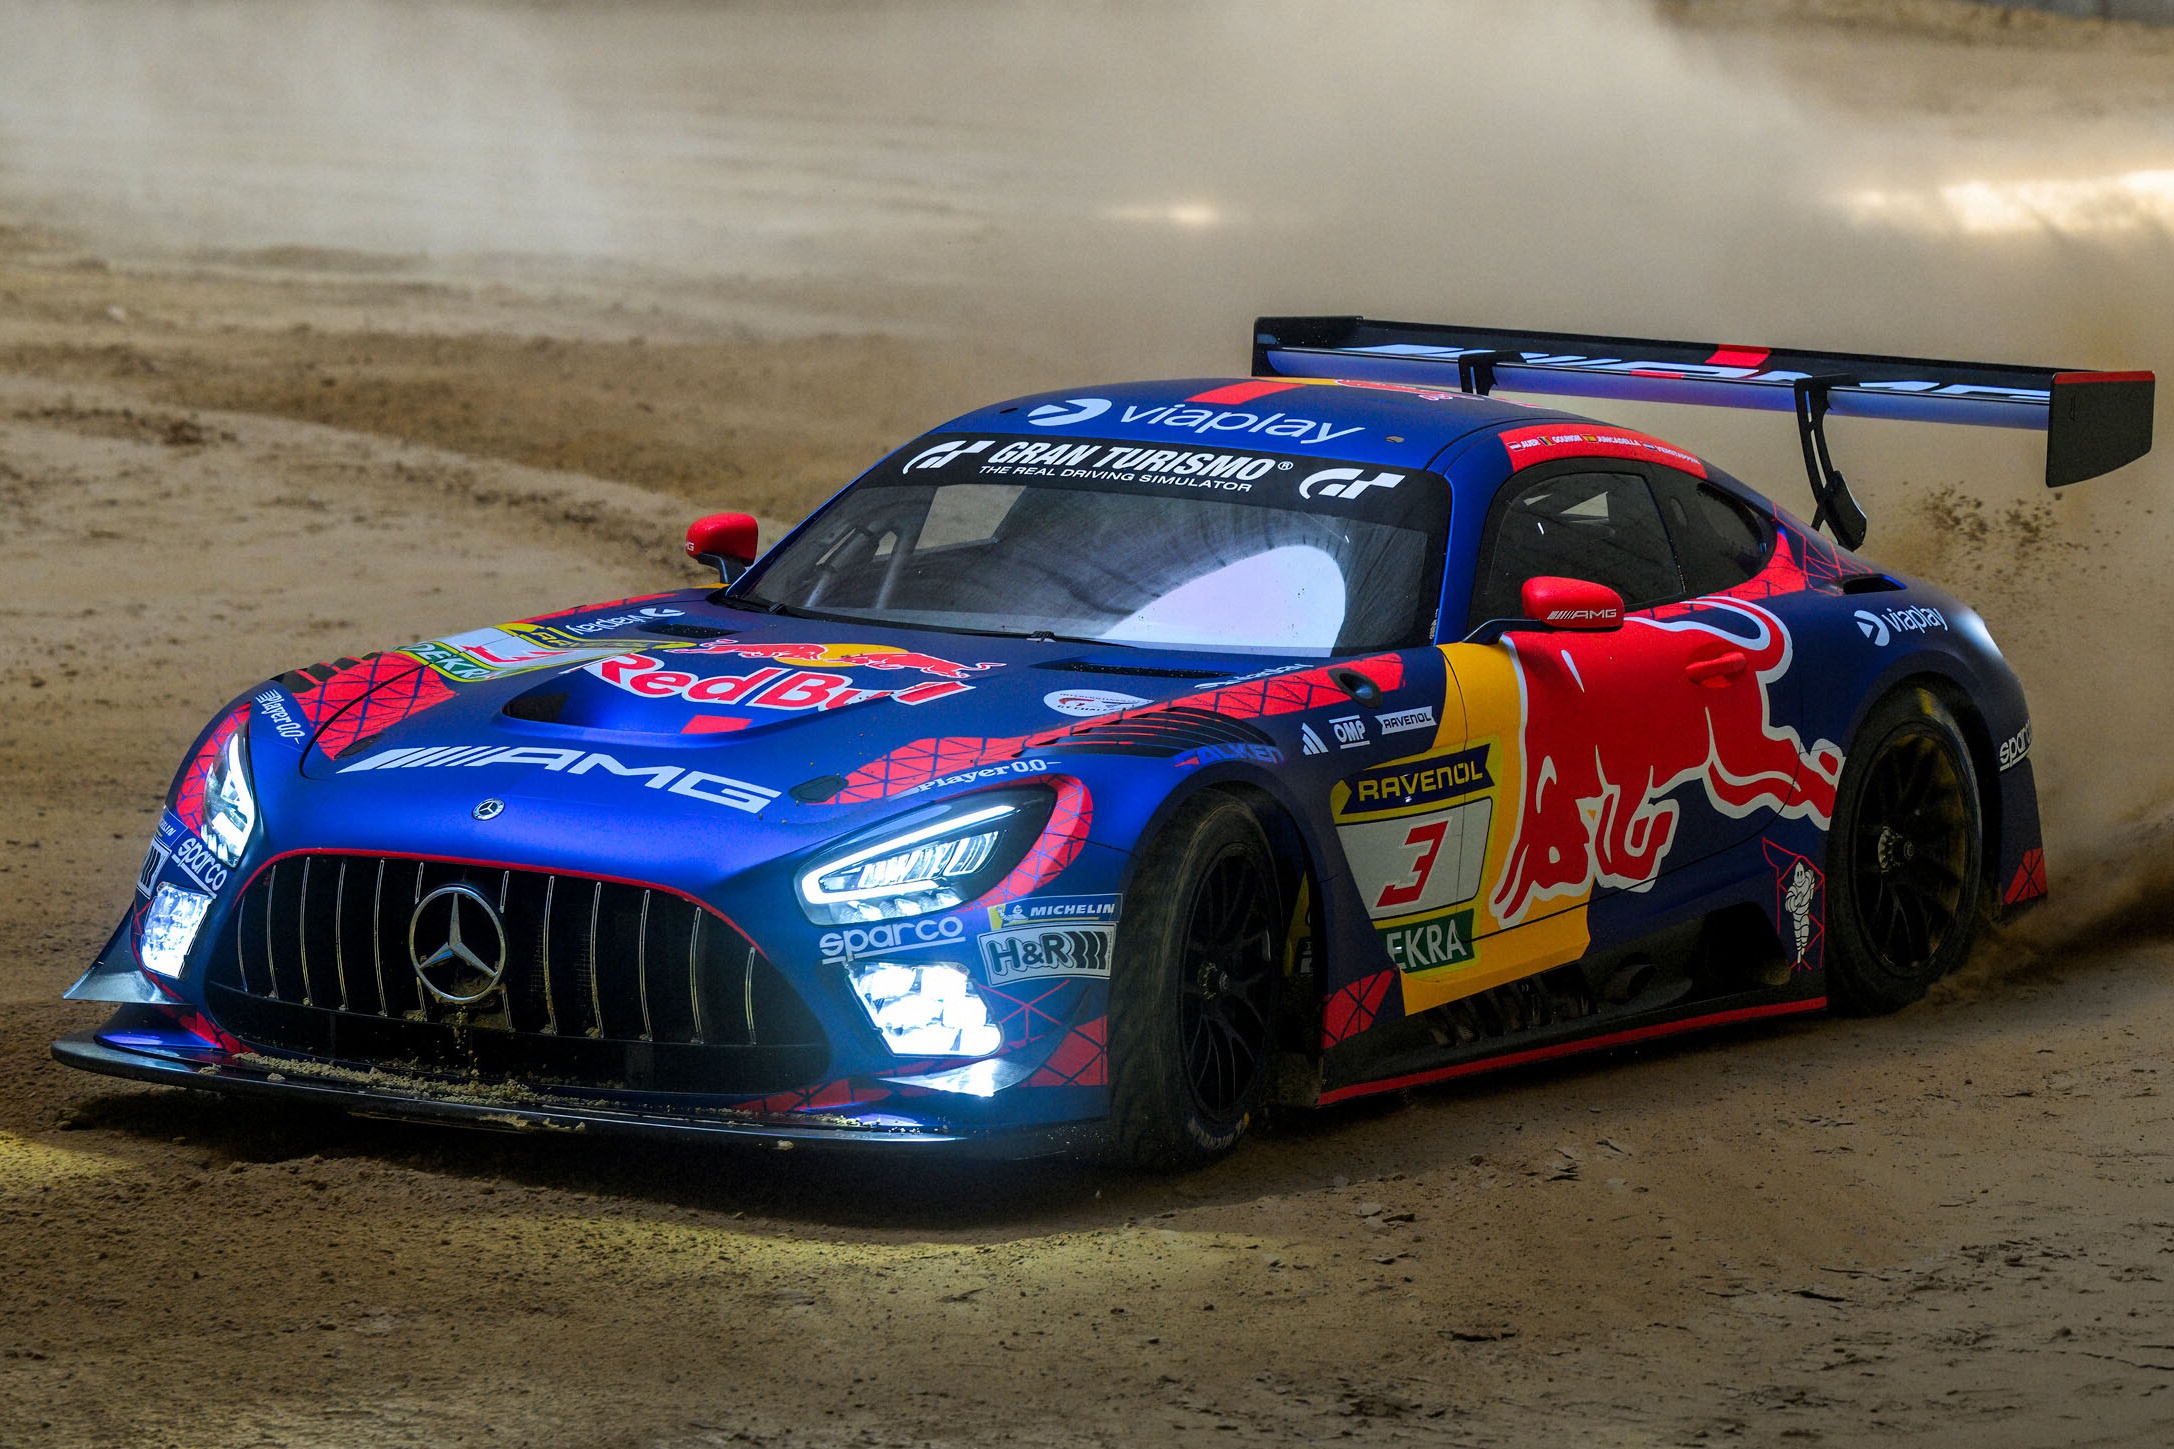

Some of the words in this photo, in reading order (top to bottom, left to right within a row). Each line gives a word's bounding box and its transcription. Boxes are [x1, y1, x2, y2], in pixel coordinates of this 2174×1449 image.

[1119, 403, 1366, 444] viaplay
[993, 441, 1098, 468] GRAN
[979, 464, 1010, 475] THE
[1014, 467, 1056, 479] REAL
[1061, 469, 1135, 484] DRIVING
[1139, 473, 1253, 493] SIMULATOR
[1881, 605, 1948, 634] viaplay
[585, 652, 790, 704] Red
[745, 671, 968, 710] Bul
[256, 689, 292, 723] Player
[275, 722, 305, 737] 0.0
[1334, 721, 1365, 743] OMP
[460, 746, 782, 812] AMG
[917, 765, 1010, 793] Player
[1011, 759, 1047, 772] 0.0
[177, 837, 227, 893] sparco
[1376, 820, 1448, 908] 3
[1030, 903, 1115, 916] MICHELIN
[819, 916, 963, 961] sparco
[990, 932, 1066, 976] H&R
